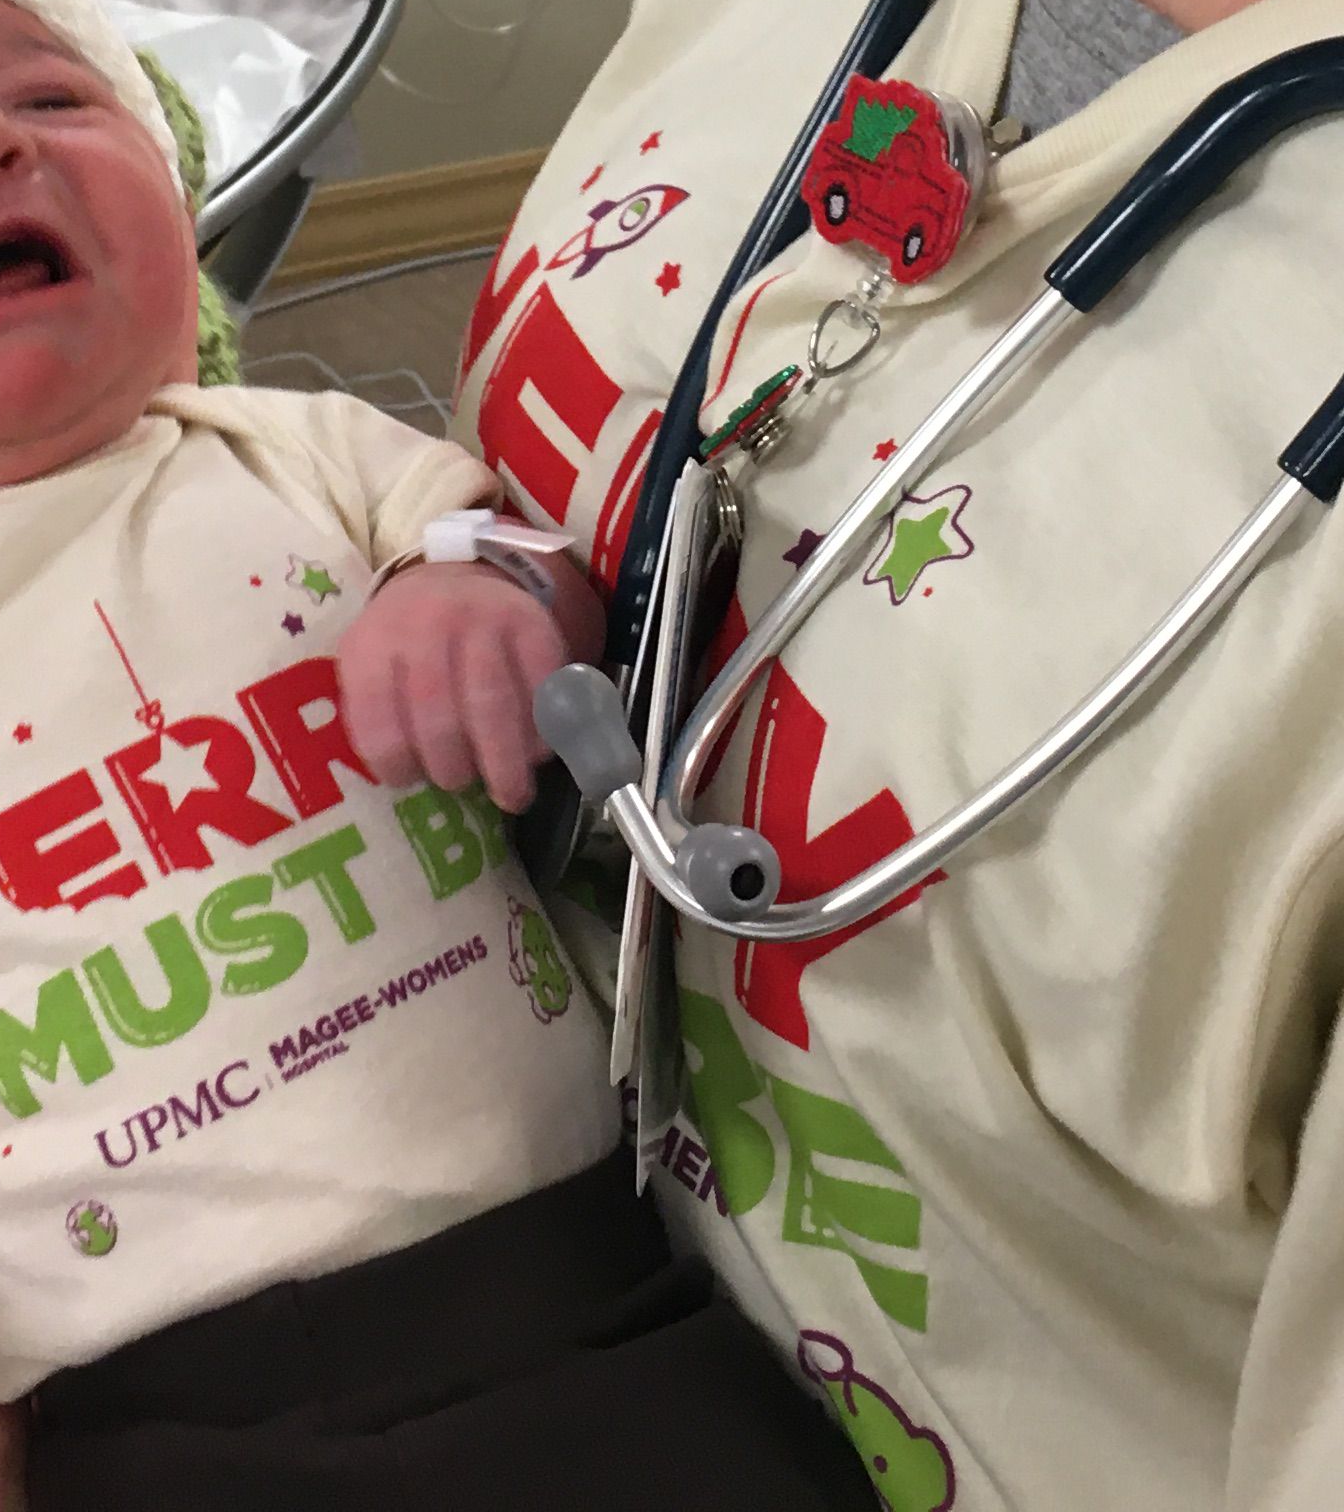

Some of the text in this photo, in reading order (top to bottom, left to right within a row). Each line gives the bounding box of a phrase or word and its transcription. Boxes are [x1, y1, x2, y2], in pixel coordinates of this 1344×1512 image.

[93, 934, 489, 1170] UPMC MAGEE-WOMENS
[280, 1041, 350, 1083] HOSPITAL
